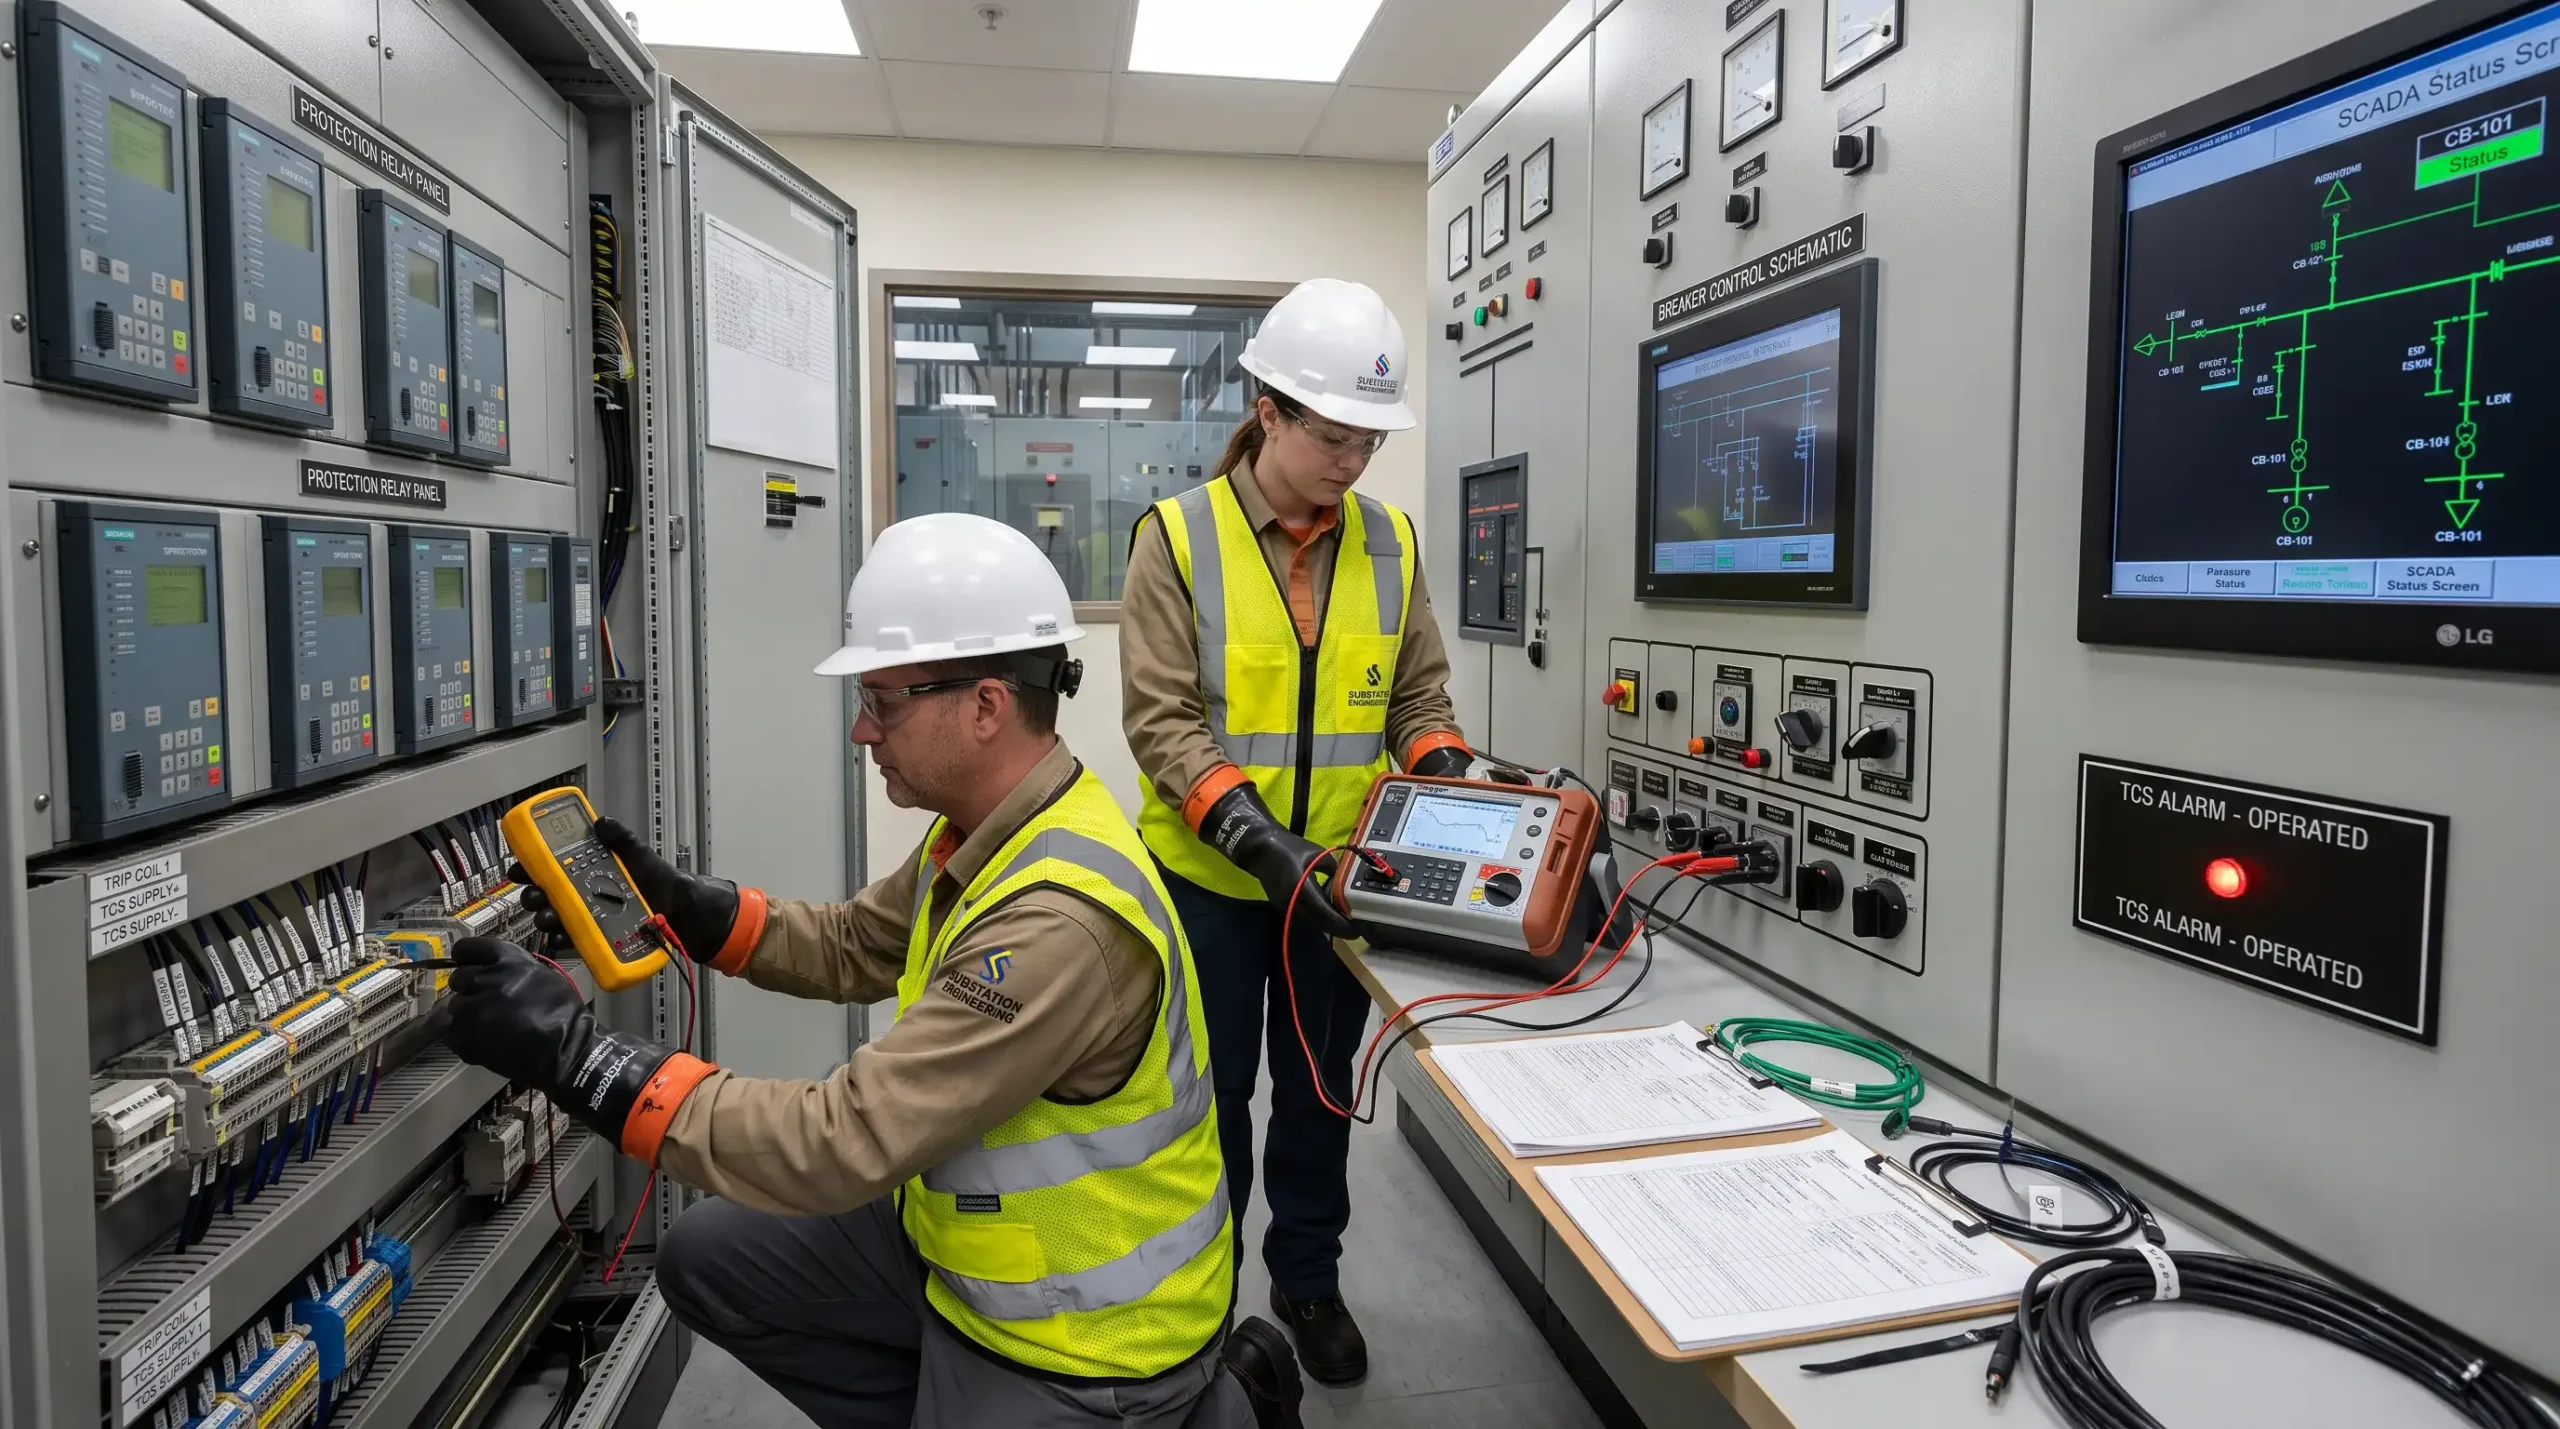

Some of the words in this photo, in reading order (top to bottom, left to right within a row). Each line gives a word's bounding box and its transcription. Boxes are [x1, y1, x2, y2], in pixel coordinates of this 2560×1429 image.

[2338, 84, 2420, 128] SCADA
[2428, 57, 2505, 97] Status
[2444, 113, 2513, 147] CB-101
[300, 97, 378, 164] PROTECTION
[381, 150, 414, 185] RELAY
[416, 173, 448, 207] PANEL
[2449, 146, 2508, 173] Status
[1658, 287, 1707, 322] BREAKER
[1709, 262, 1766, 301] CONTROL
[1769, 226, 1852, 278] SCHEMATIC
[2251, 453, 2286, 466] CB-101
[307, 468, 378, 494] PROTECTION
[381, 478, 412, 498] RELAY
[413, 483, 442, 502] PANEL
[2276, 536, 2313, 546] CB-101
[2434, 531, 2482, 542] CB-101
[2206, 567, 2251, 577] Parasure
[2215, 579, 2246, 588] Status
[2387, 580, 2428, 591] Status
[2432, 580, 2480, 592] Screen
[2406, 566, 2456, 577] SCADA
[2465, 628, 2494, 645] LG
[2120, 781, 2154, 806] TCS
[2158, 790, 2226, 821] ALARM
[2248, 806, 2369, 851] OPERATED
[104, 872, 132, 891] TRIP
[135, 864, 162, 882] COIL
[164, 860, 169, 872] 1
[100, 900, 125, 919] TCS
[102, 925, 127, 945] TCS
[2115, 897, 2149, 924] TCS
[2153, 909, 2221, 946] ALARM
[2243, 935, 2363, 990] OPERATED
[948, 970, 1024, 1013] SUBSTATION
[137, 1331, 162, 1358] TRIP
[164, 1311, 189, 1337] COIL
[157, 1329, 196, 1368] SUPPLY
